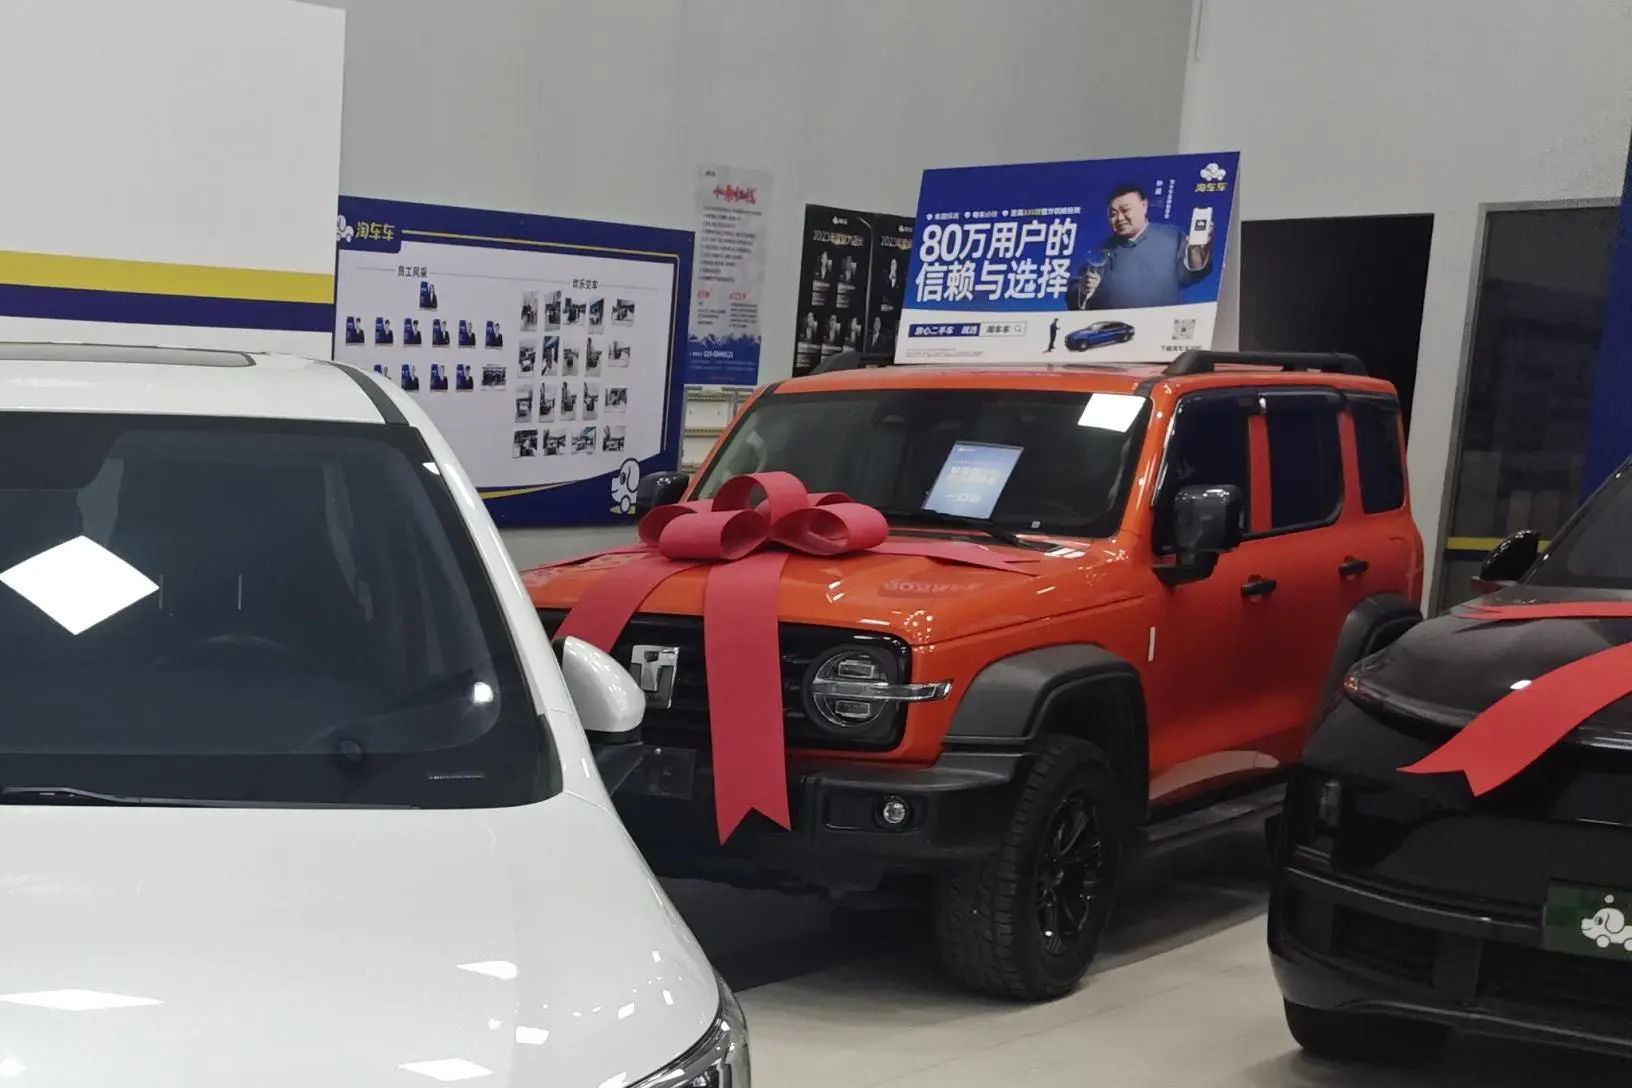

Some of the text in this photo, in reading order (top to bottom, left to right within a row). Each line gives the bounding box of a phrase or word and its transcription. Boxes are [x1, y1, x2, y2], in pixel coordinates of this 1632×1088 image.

[355, 221, 396, 242] 淘车车
[919, 219, 1077, 262] 80万用户的
[397, 265, 428, 279] 员工风采
[915, 258, 1071, 302] 信赖与选择
